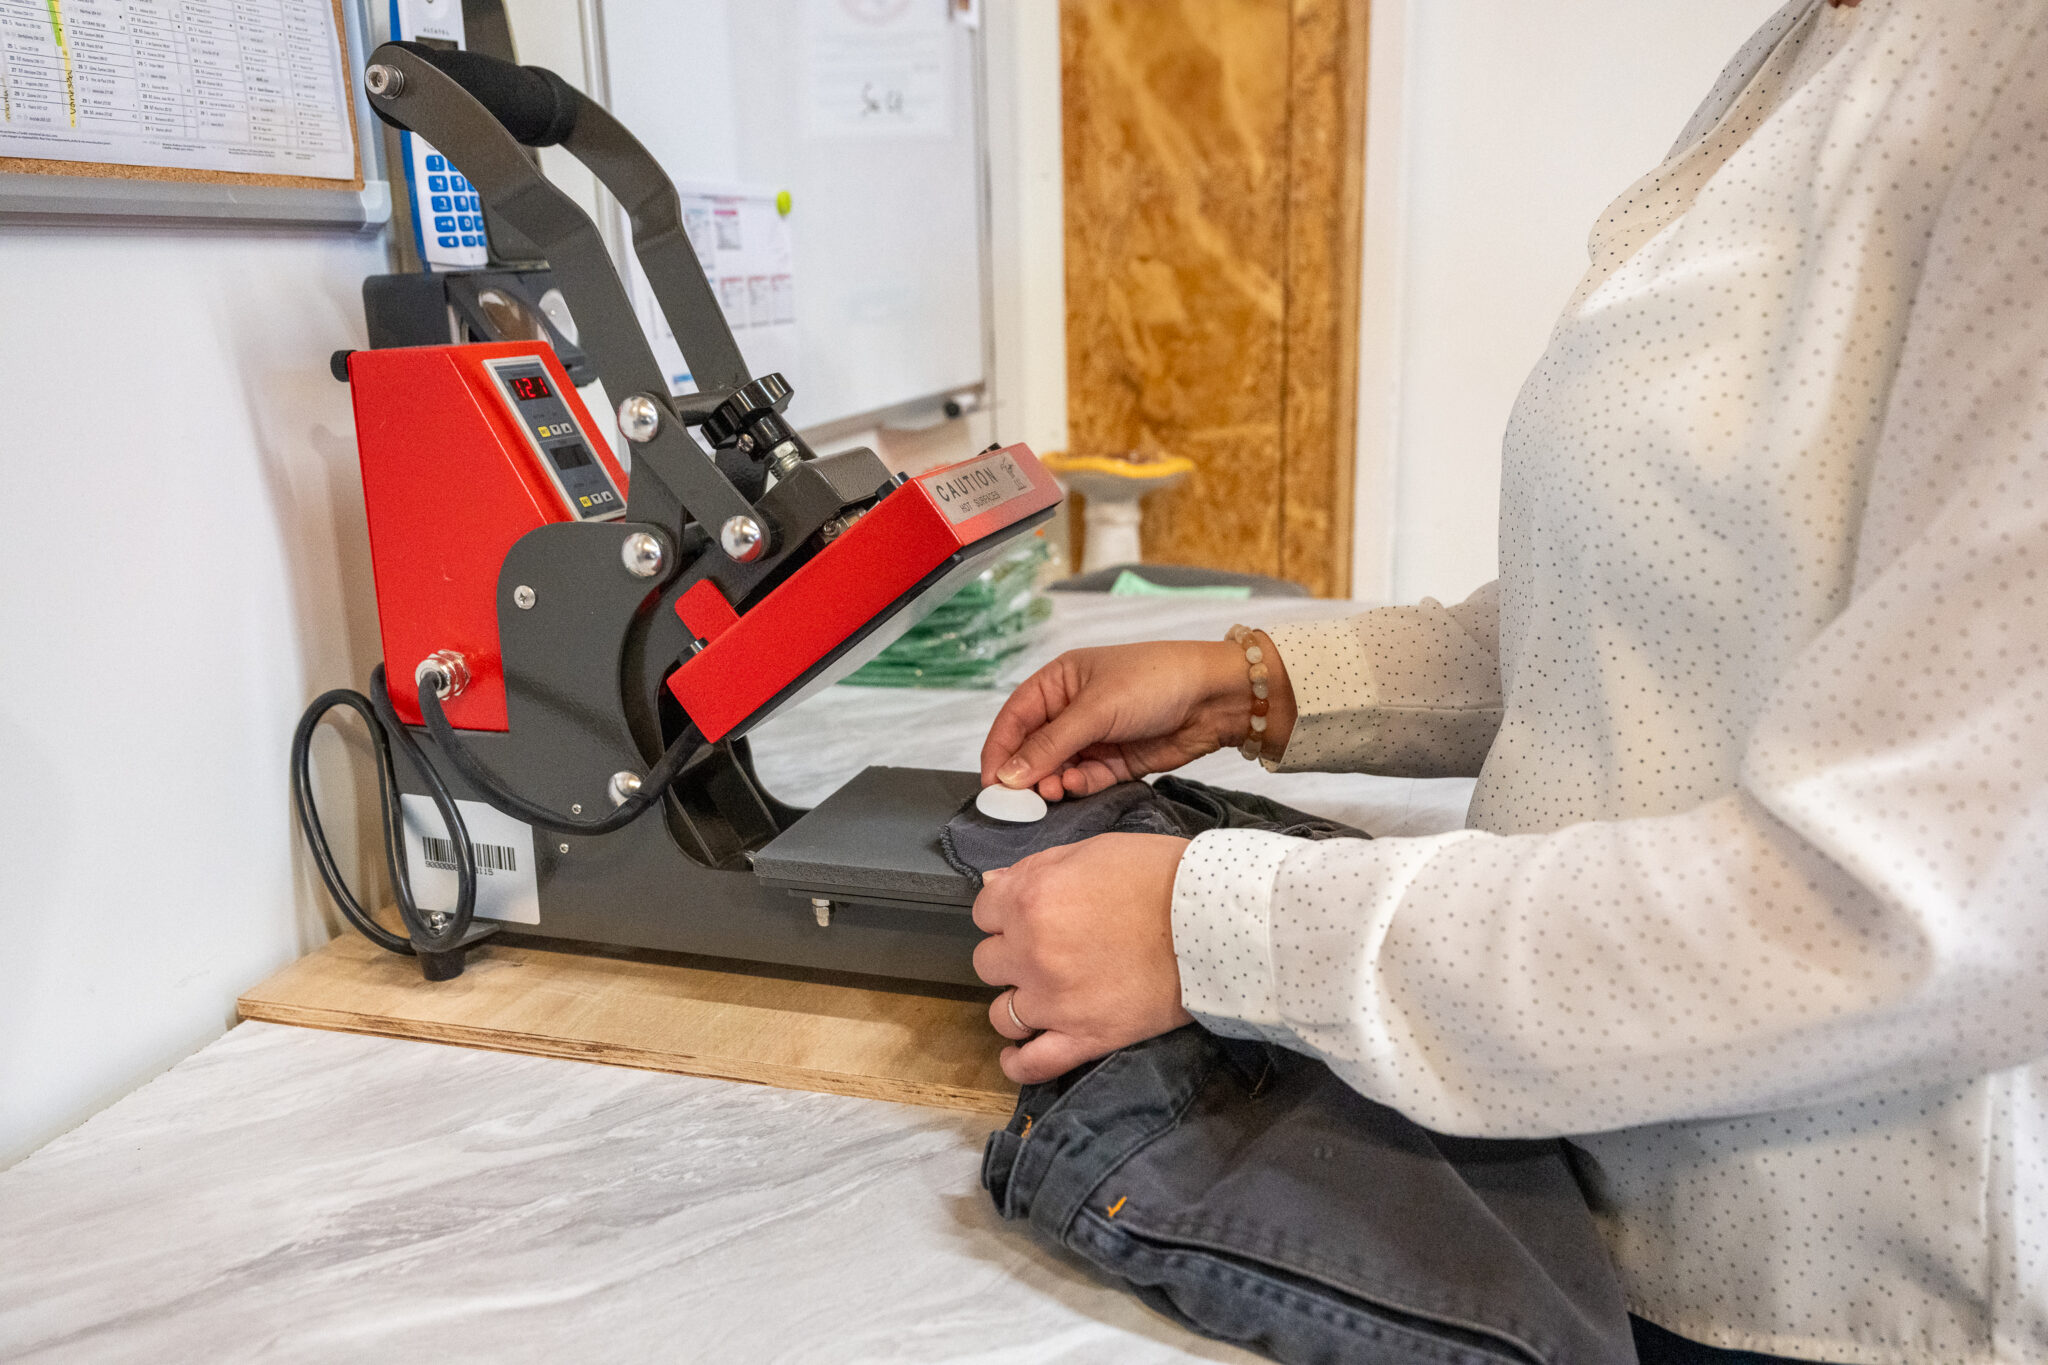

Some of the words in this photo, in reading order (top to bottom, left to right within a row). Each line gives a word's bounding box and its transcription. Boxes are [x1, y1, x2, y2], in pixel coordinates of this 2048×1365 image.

[514, 378, 548, 398] 121
[935, 467, 998, 502] CAUTION
[960, 502, 973, 513] HOT
[973, 490, 1000, 507] SURFACES
